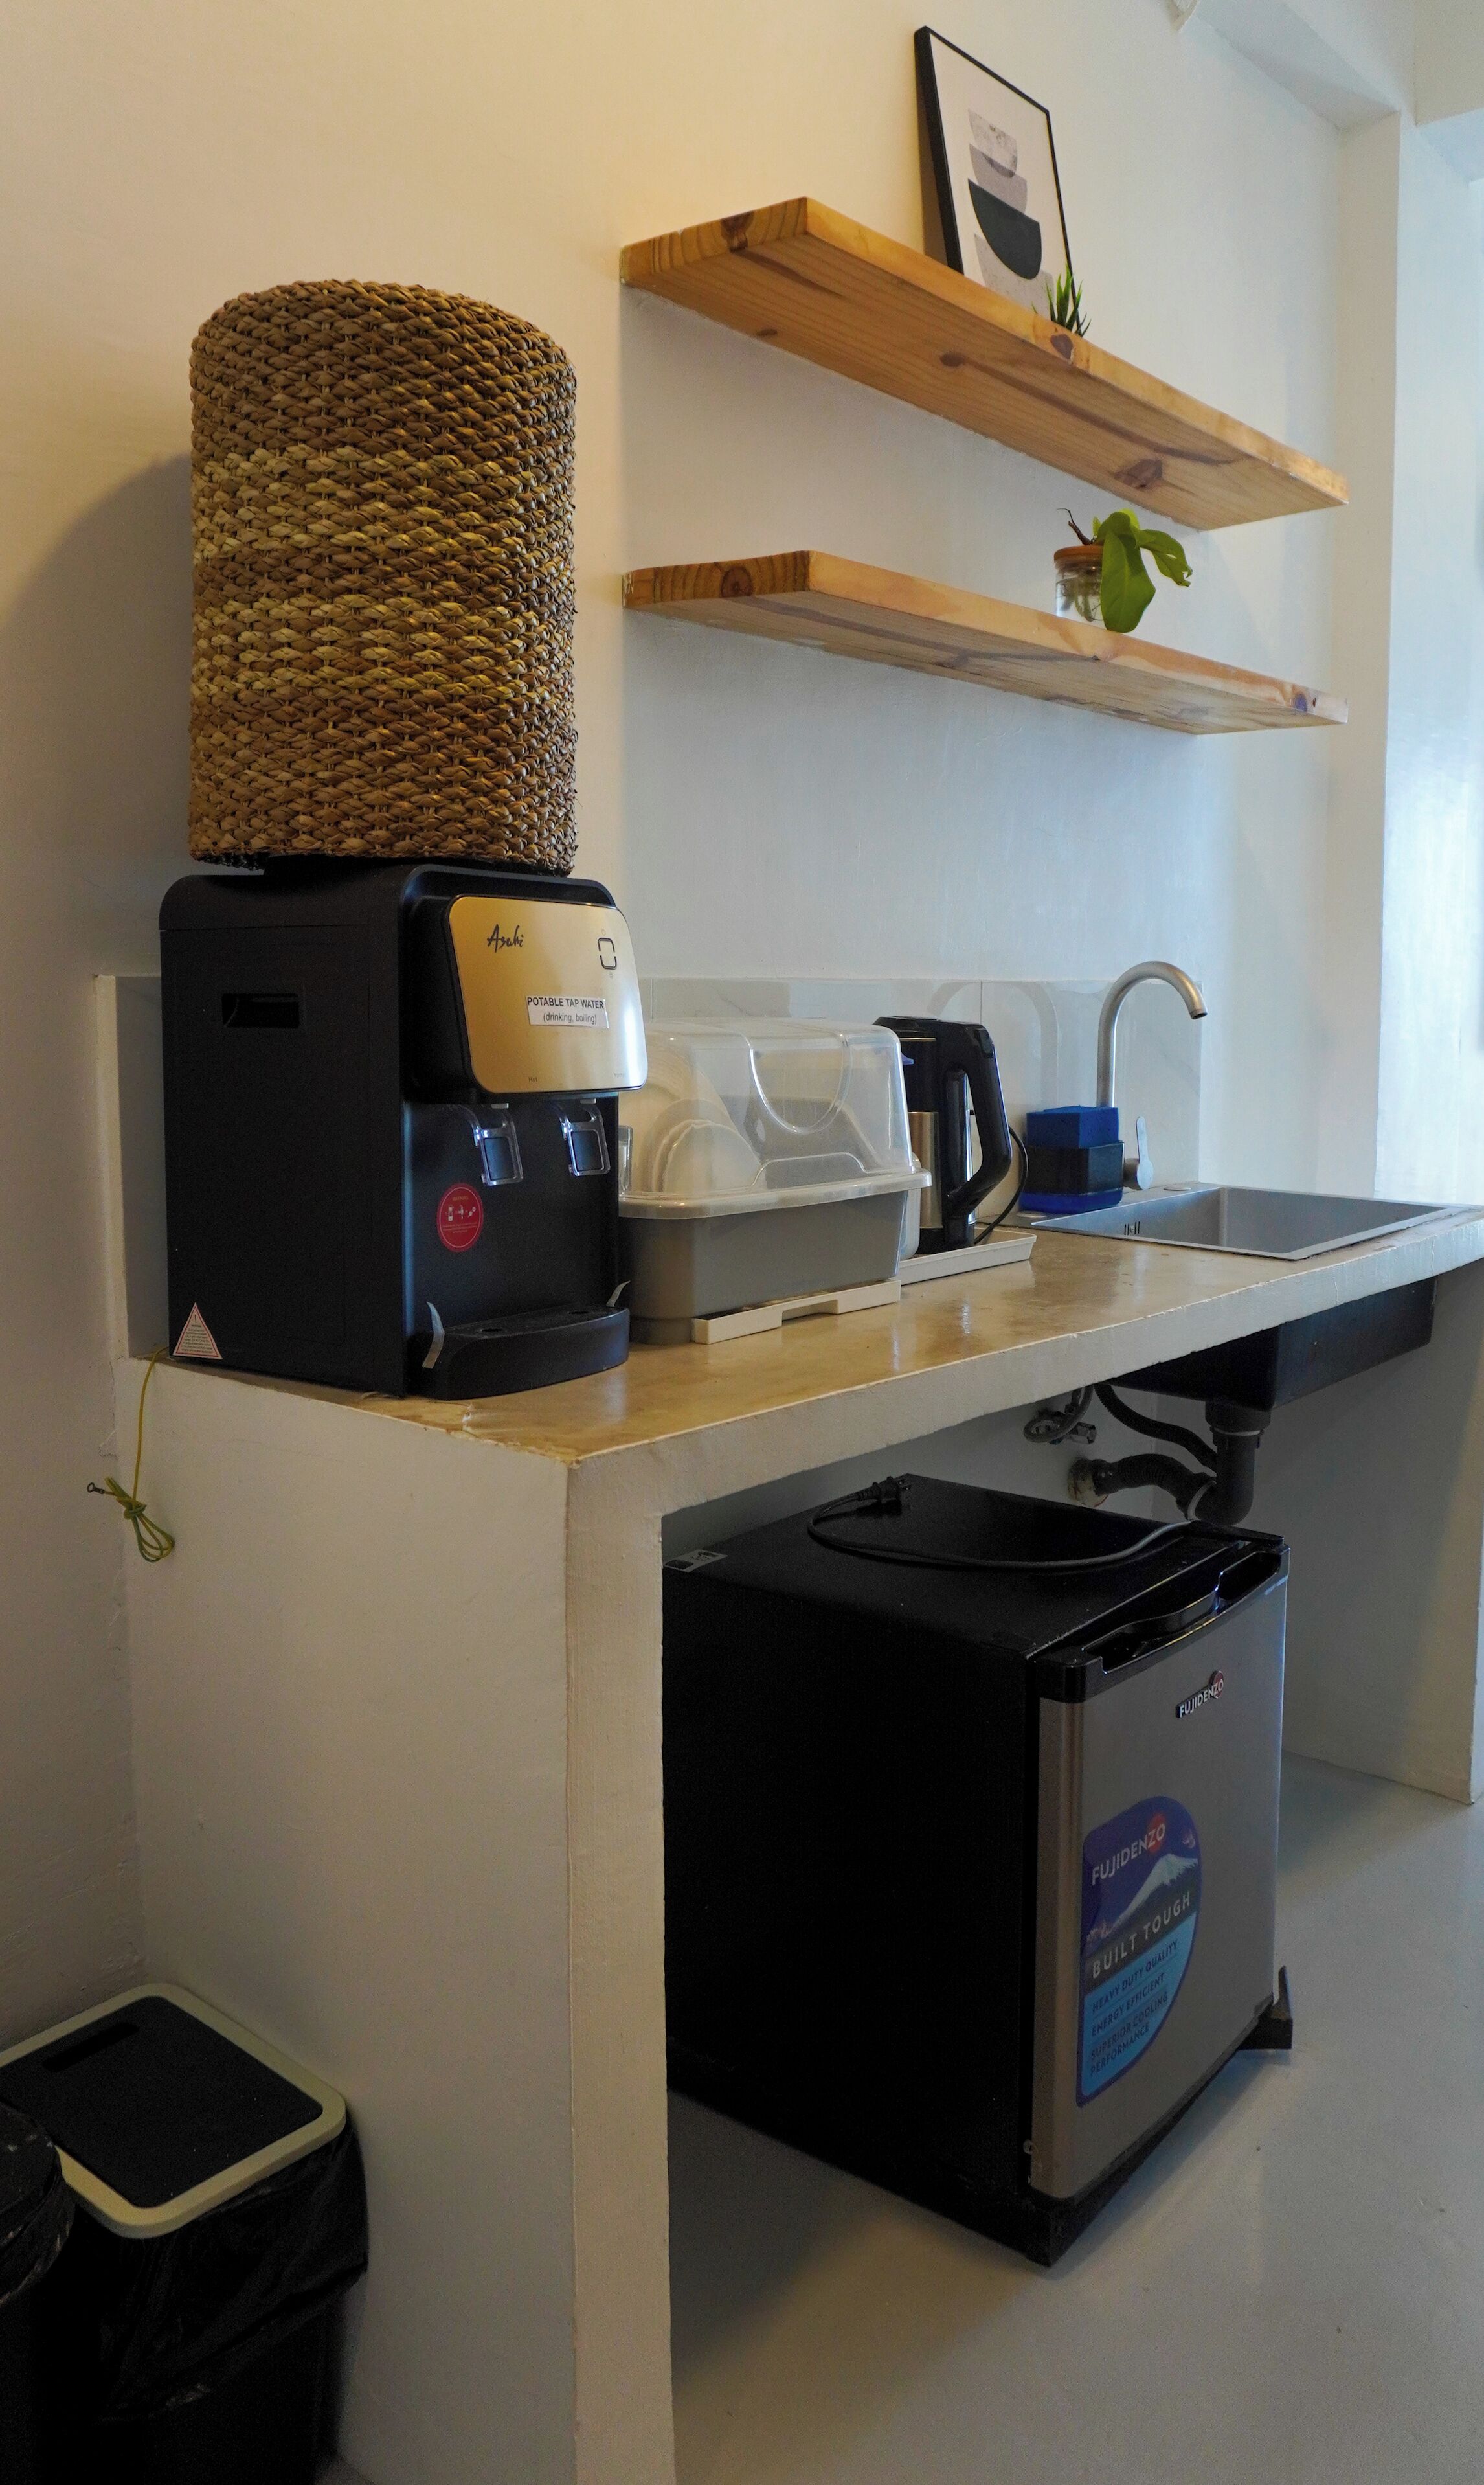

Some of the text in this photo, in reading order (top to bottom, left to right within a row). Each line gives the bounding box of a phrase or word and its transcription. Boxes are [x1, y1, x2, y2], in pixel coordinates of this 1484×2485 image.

[487, 924, 524, 953] Asahi
[527, 997, 604, 1009] POTABLE TAP WATER
[543, 1012, 597, 1025] (drinking, boiling)
[1179, 1679, 1224, 1718] FUJIDENZO
[1092, 1823, 1165, 1885] FUJIDENZO
[1093, 1891, 1189, 1979] BUILT TOUGH
[1092, 1939, 1178, 2013] HEAVY DUTY QUALITY
[1092, 1973, 1165, 2036] ENERGY EFFICIENT
[1090, 2022, 1150, 2076] PERFORMANCE
[1091, 1991, 1168, 2061] SUPERIOR COOLING
